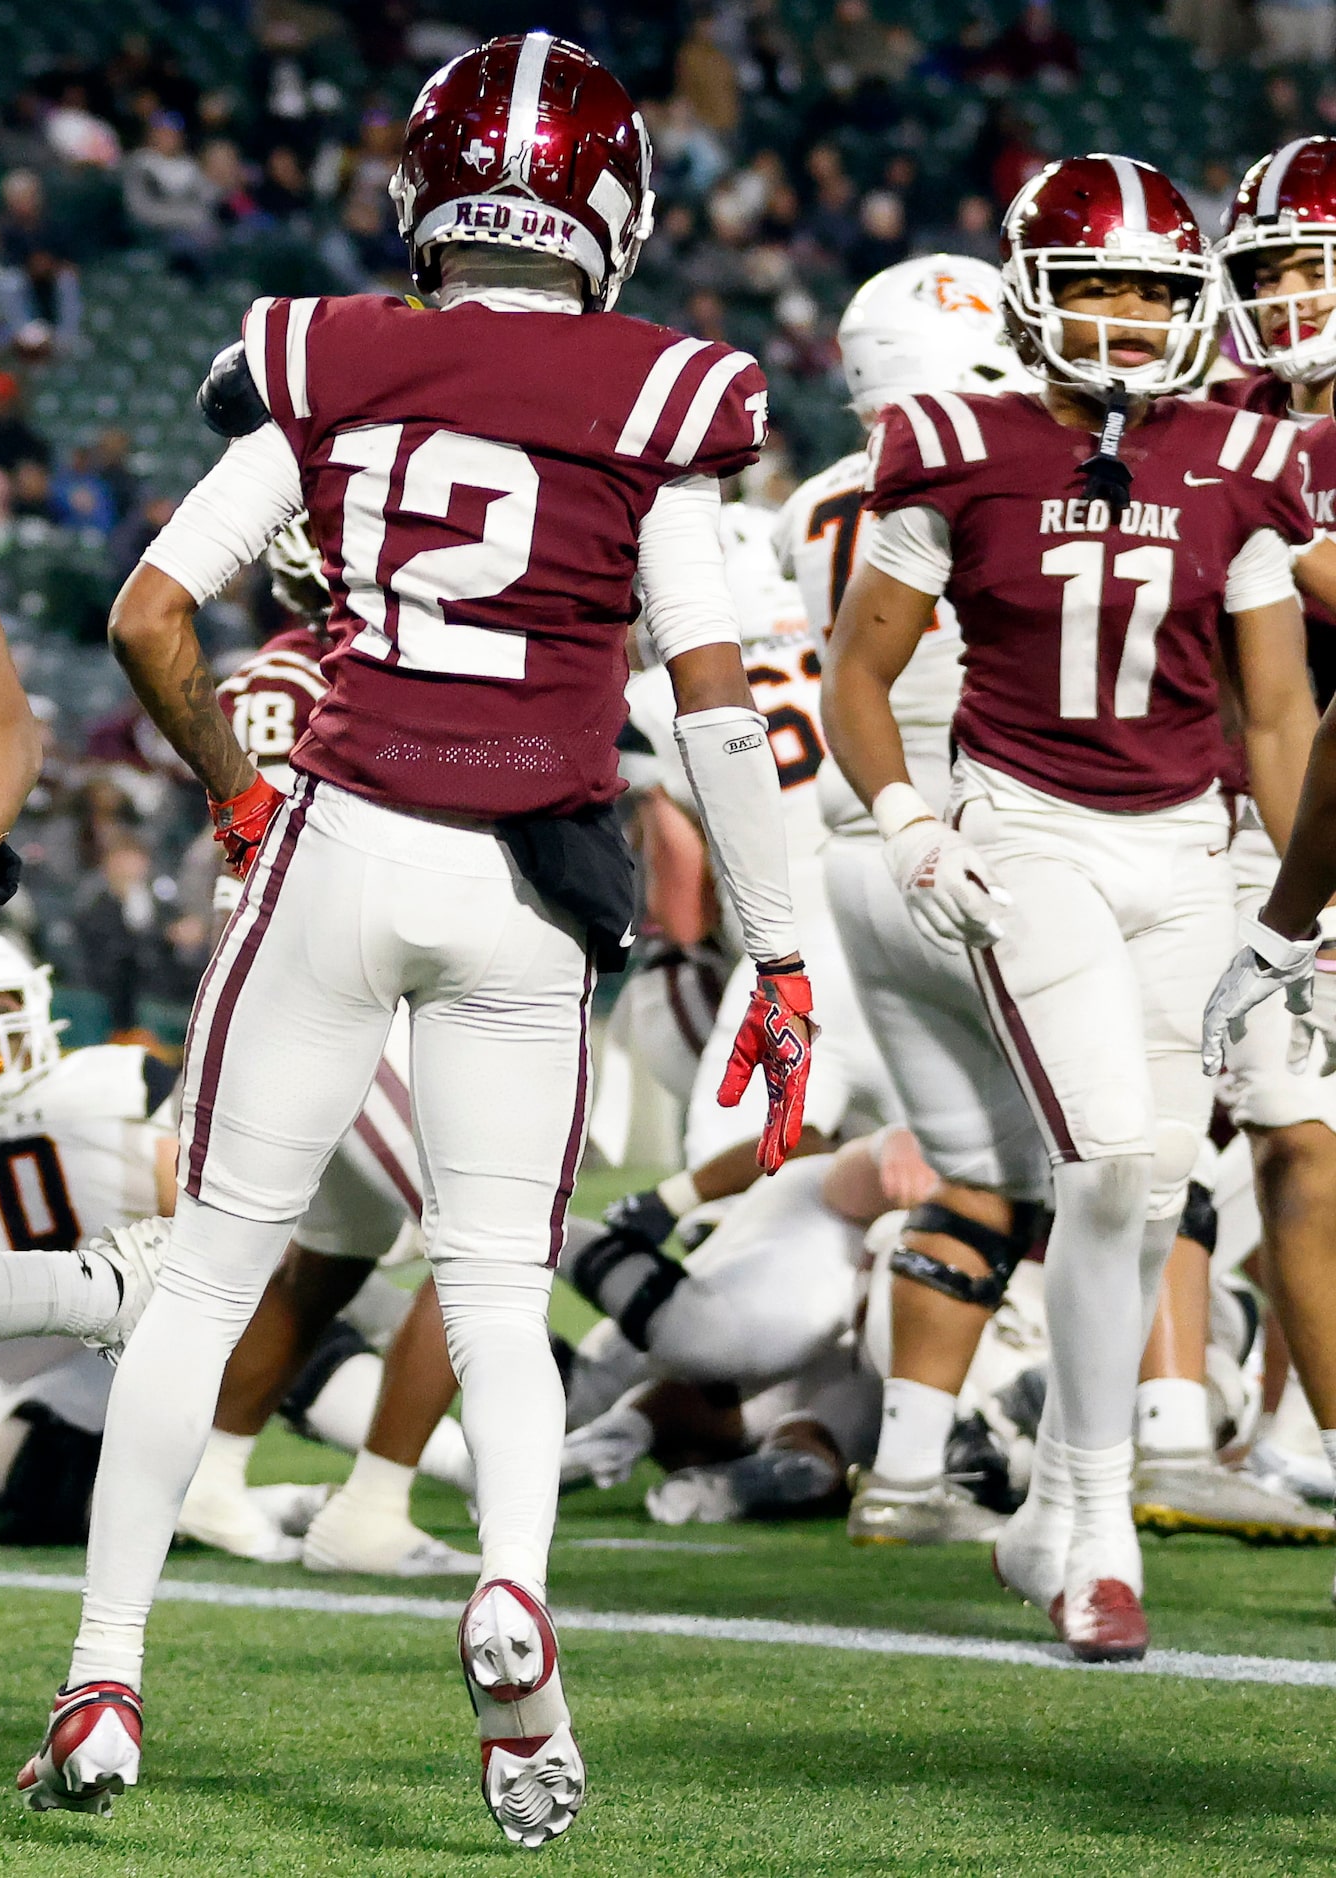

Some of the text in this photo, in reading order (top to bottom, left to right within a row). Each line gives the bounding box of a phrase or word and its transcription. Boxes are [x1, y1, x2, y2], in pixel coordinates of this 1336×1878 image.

[456, 202, 578, 243] RED OAK
[1100, 411, 1125, 456] NXTRND
[1040, 498, 1181, 540] RED OAK
[328, 423, 540, 680] 12
[1041, 541, 1174, 719] 11
[232, 691, 296, 755] 18
